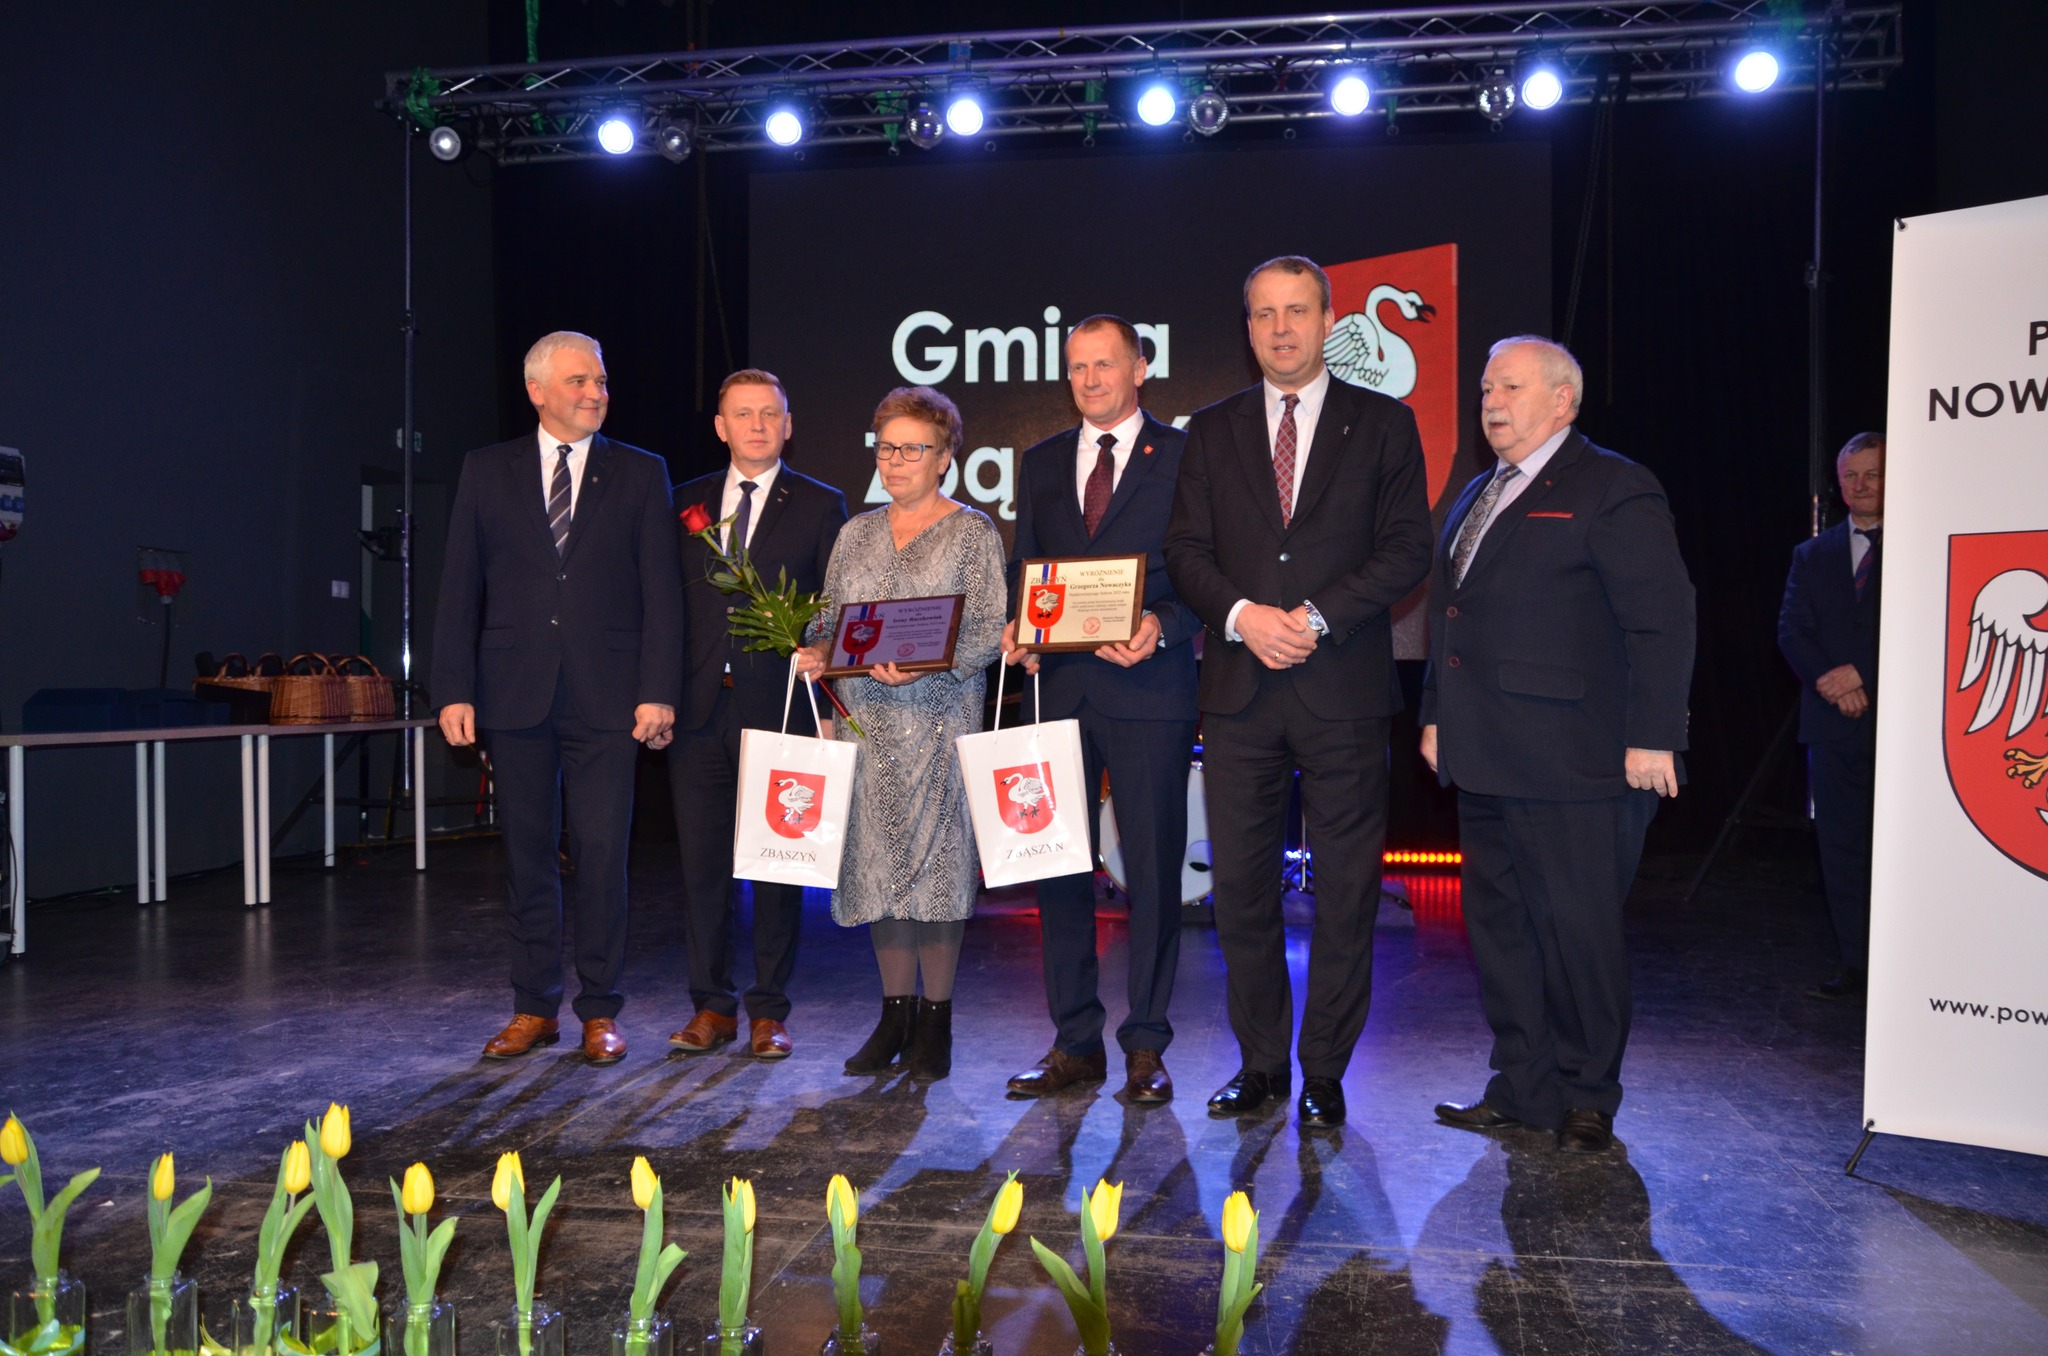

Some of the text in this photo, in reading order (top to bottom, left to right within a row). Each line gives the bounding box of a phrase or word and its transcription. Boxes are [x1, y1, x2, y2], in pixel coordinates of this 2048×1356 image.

[891, 305, 1170, 385] Gmia
[760, 847, 816, 863] ZBĄSZYŃ
[1929, 998, 2048, 1026] www.pow
